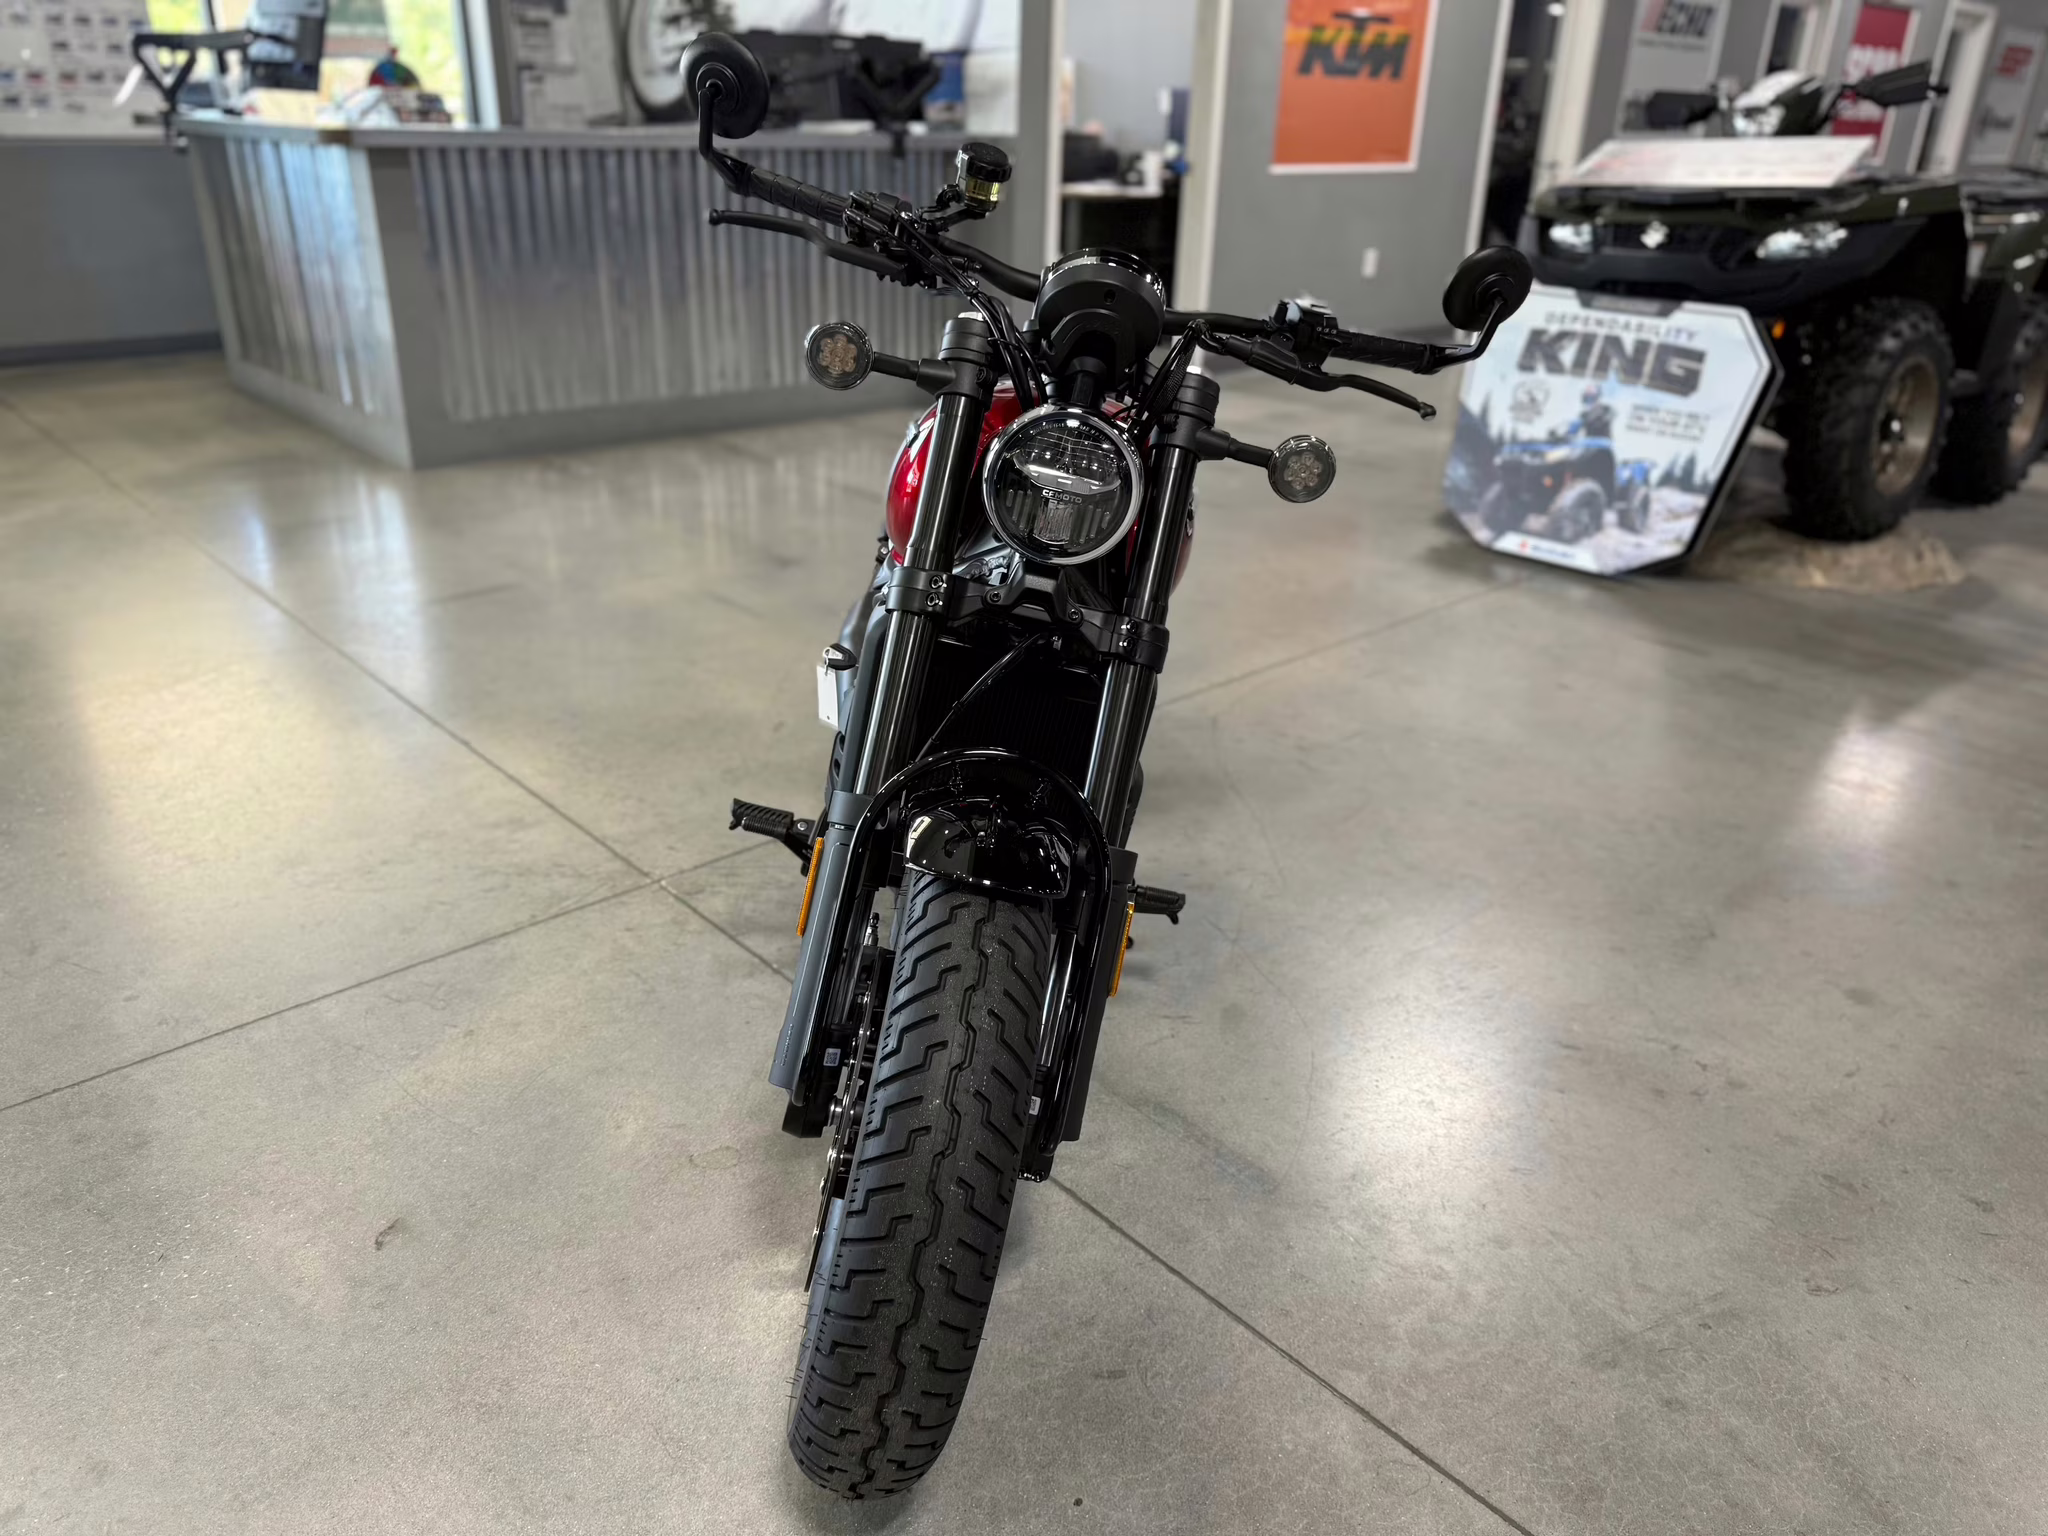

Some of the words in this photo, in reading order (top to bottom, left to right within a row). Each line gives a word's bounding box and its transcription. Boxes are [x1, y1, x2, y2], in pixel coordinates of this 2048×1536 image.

[1298, 12, 1411, 80] KTM
[1544, 310, 1699, 342] DEPENDABILITY
[1516, 328, 1706, 397] KING
[1042, 489, 1083, 504] CFMOTO
